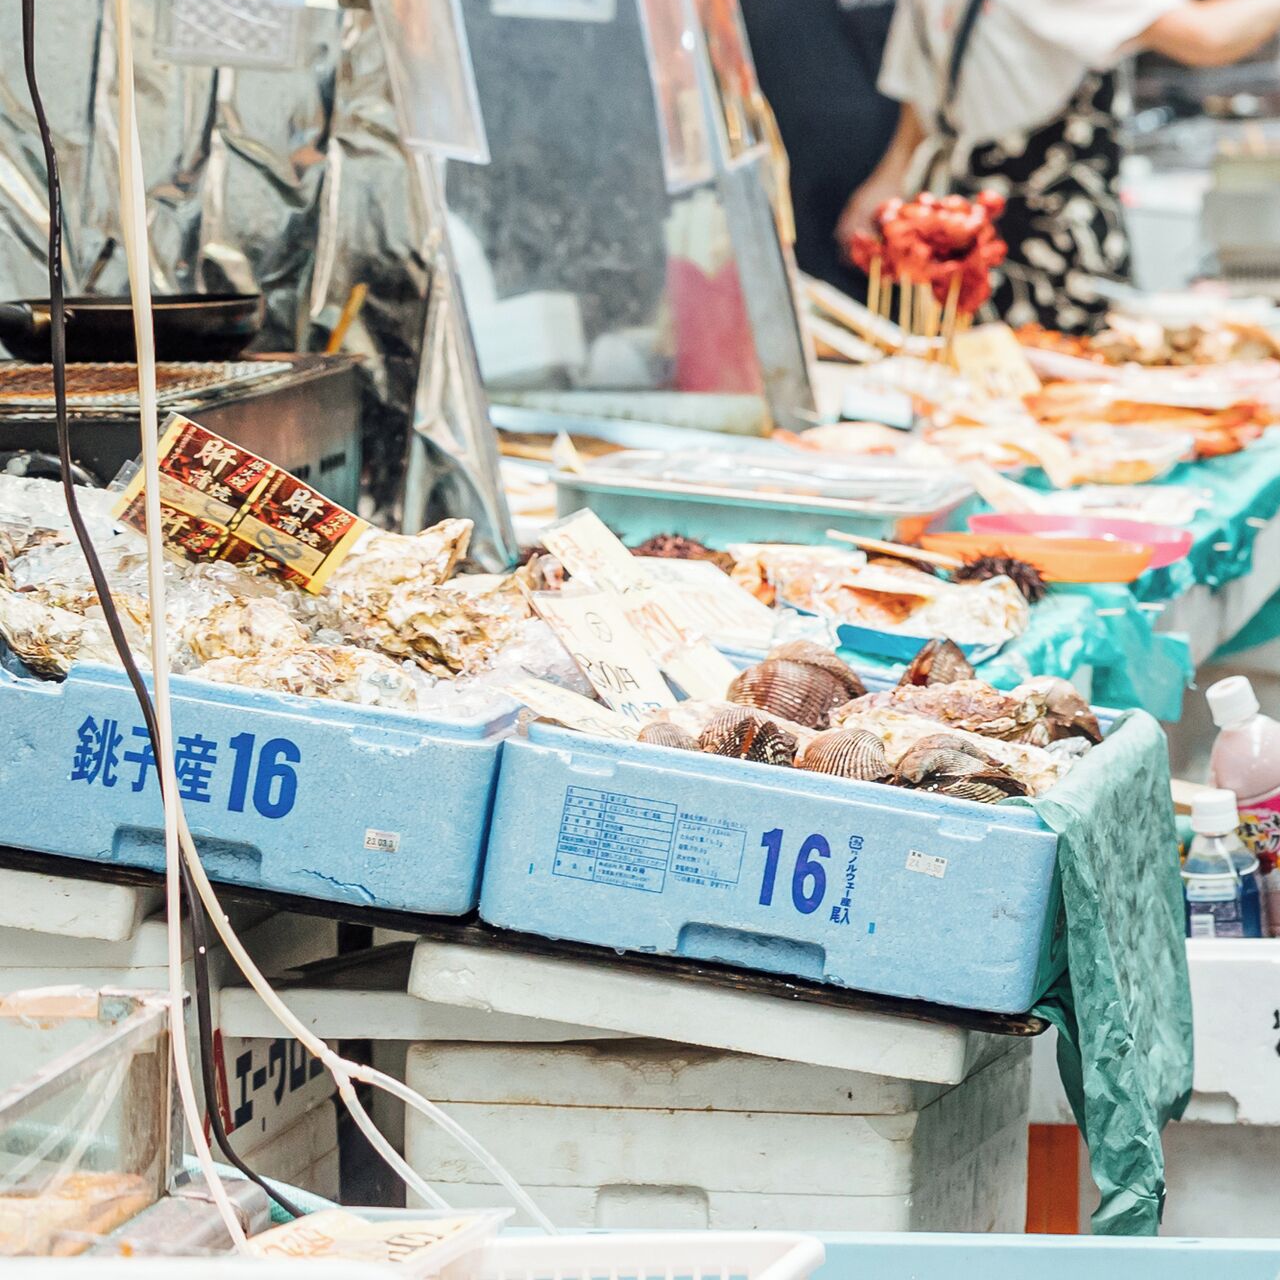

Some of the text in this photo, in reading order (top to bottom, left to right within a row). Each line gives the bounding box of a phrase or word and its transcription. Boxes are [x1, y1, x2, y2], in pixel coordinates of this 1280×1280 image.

[194, 439, 238, 477] 肝
[282, 487, 325, 523] 肝
[758, 827, 832, 915] 16
